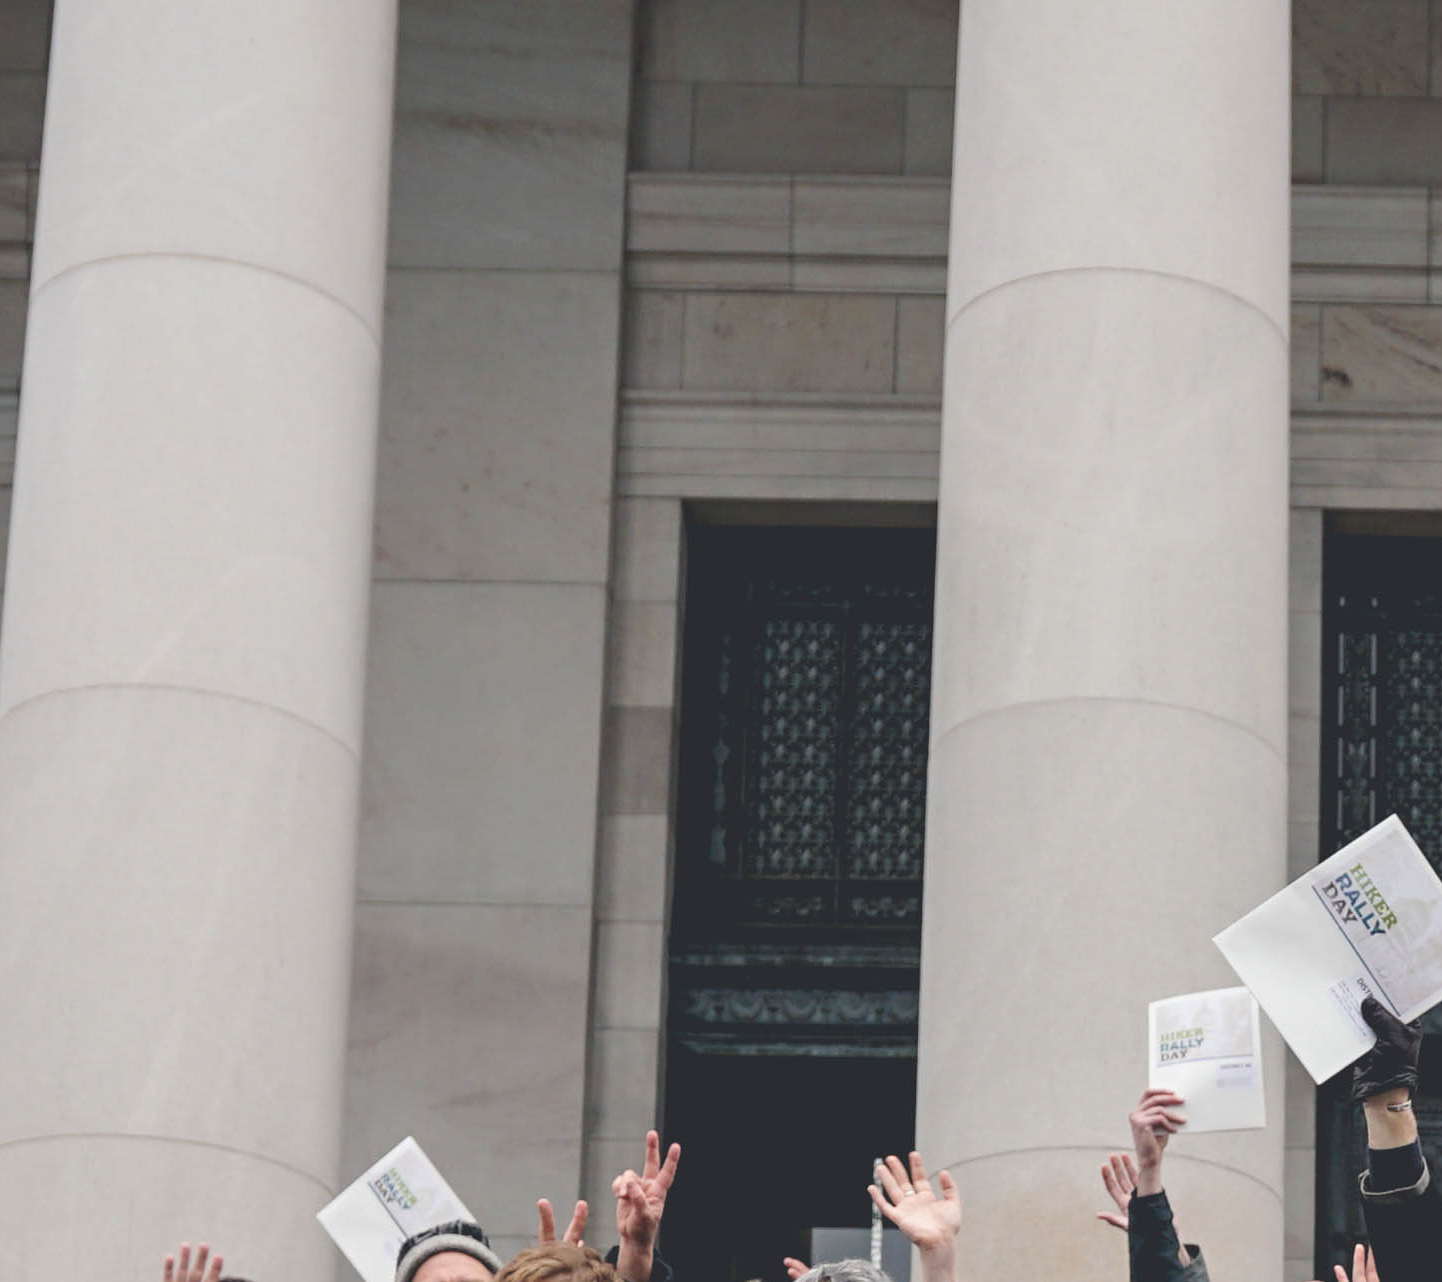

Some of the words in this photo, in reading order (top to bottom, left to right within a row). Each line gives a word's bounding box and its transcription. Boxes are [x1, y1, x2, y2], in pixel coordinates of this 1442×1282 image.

[1323, 881, 1358, 924] DAY
[1335, 873, 1386, 936] RALLY
[1349, 864, 1398, 930] HIKER
[1160, 1037, 1205, 1052] RALLY
[1160, 1048, 1188, 1062] DAY
